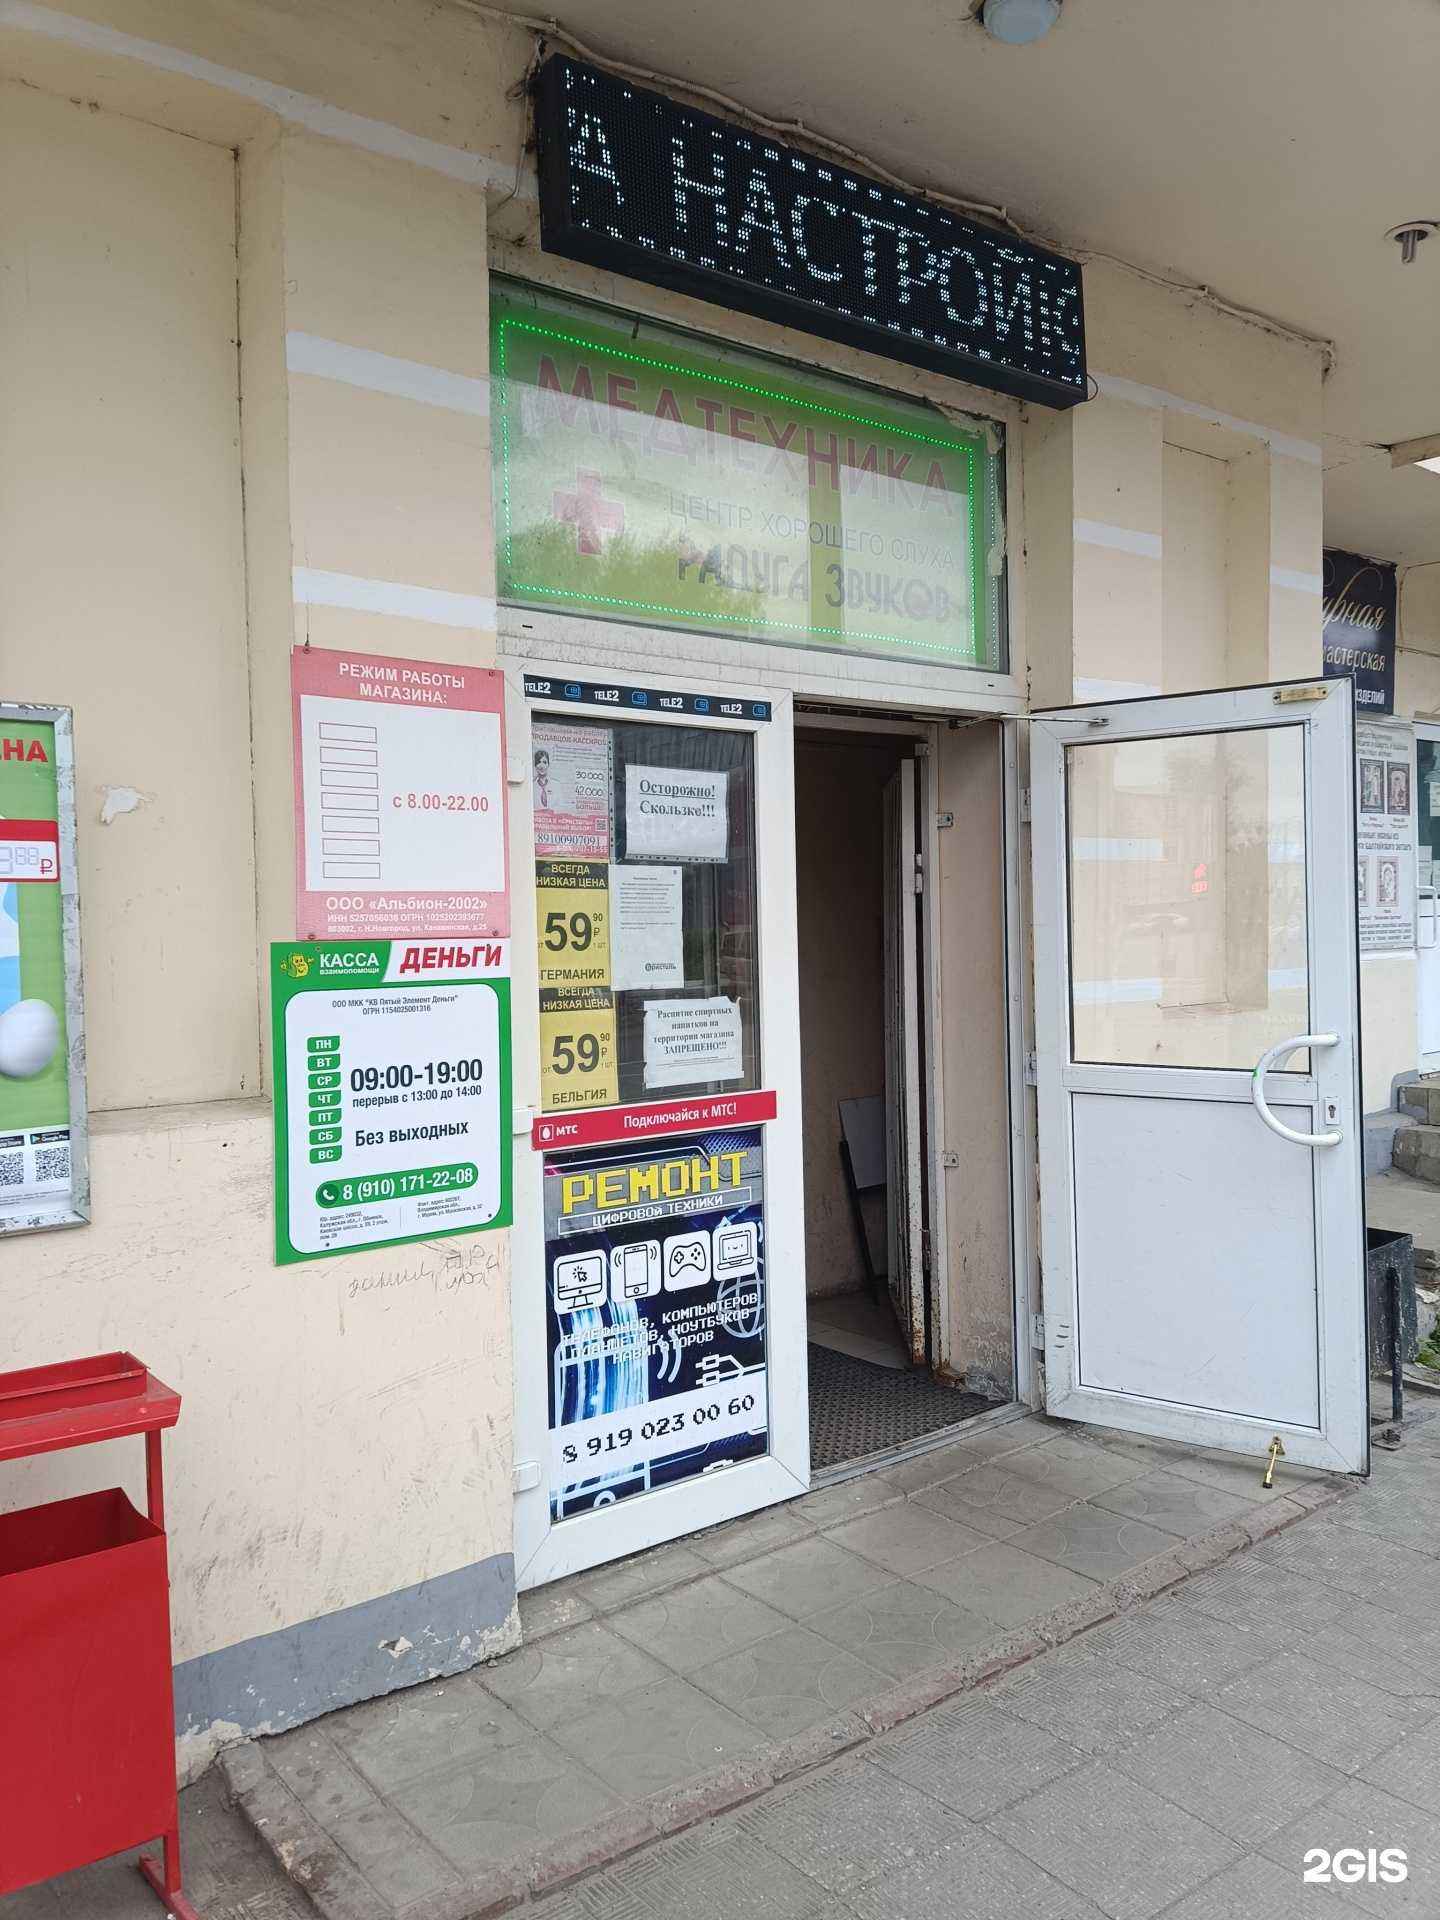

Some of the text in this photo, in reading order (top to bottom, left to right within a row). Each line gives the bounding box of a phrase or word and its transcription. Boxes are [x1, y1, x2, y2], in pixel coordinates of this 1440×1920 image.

[536, 354, 952, 515] МЕДТЕХНИКА
[670, 491, 953, 569] ЦЕНТР ХОРОШЕГО СЛУХА
[824, 562, 952, 623] ЗВУКОВ
[339, 662, 465, 689] РЕЖИМ РАБОТЫ
[359, 683, 448, 705] МАГАЗИНА:
[524, 682, 551, 694] TELE2
[594, 690, 619, 702] TELE2
[660, 697, 684, 709] TELE2
[720, 703, 743, 715] TELE2
[639, 779, 715, 799] Осторожно!
[393, 793, 489, 812] с 8.00-22.00
[639, 800, 715, 817] Скользко!!!
[551, 864, 590, 875] ВСЕГДА
[536, 876, 606, 888] НИЗКАЯ ЦЕНА
[326, 896, 488, 911] ООО «Альбион-2002»
[544, 912, 603, 952] 59 90
[319, 952, 380, 968] КАССА
[399, 946, 502, 974] ДЕНЬГИ
[540, 968, 605, 981] ГЕРМАНИЯ
[558, 986, 595, 997] ВСЕГДА
[332, 1000, 346, 1008] ООО
[348, 999, 364, 1007] МКК
[362, 1006, 380, 1016] ОГРН
[542, 998, 610, 1011] НИЗКАЯ ЦЕНА
[657, 1007, 733, 1019] Распитие спиртных
[671, 1021, 708, 1030] напитков
[315, 1039, 332, 1050] ПН
[316, 1057, 332, 1067] ВТ
[551, 1033, 610, 1075] 59 90
[316, 1075, 332, 1086] СР
[350, 1059, 483, 1092] 09:00-19:00
[317, 1094, 333, 1104] ЧТ
[352, 1085, 482, 1109] перерыв с 13:00 до 14:00
[552, 1088, 607, 1105] БЕЛЬГИЯ
[317, 1112, 333, 1123] ПТ
[623, 1102, 737, 1129] Подключайся к МТС!
[318, 1131, 334, 1141] СБ
[355, 1122, 469, 1147] Без выходных
[318, 1149, 334, 1160] ВС
[342, 1185, 353, 1200] 8
[357, 1177, 395, 1202] (910)
[400, 1166, 474, 1193] 171-22-08
[562, 1151, 748, 1216] РЕМОНТ
[667, 1195, 723, 1215] ТЕХНИКИ
[662, 1293, 759, 1325] КОМПЬЮТЕРОВ
[671, 1308, 750, 1335] НОУТБУКОВ
[563, 1394, 755, 1464] 8 919 023 00 60
